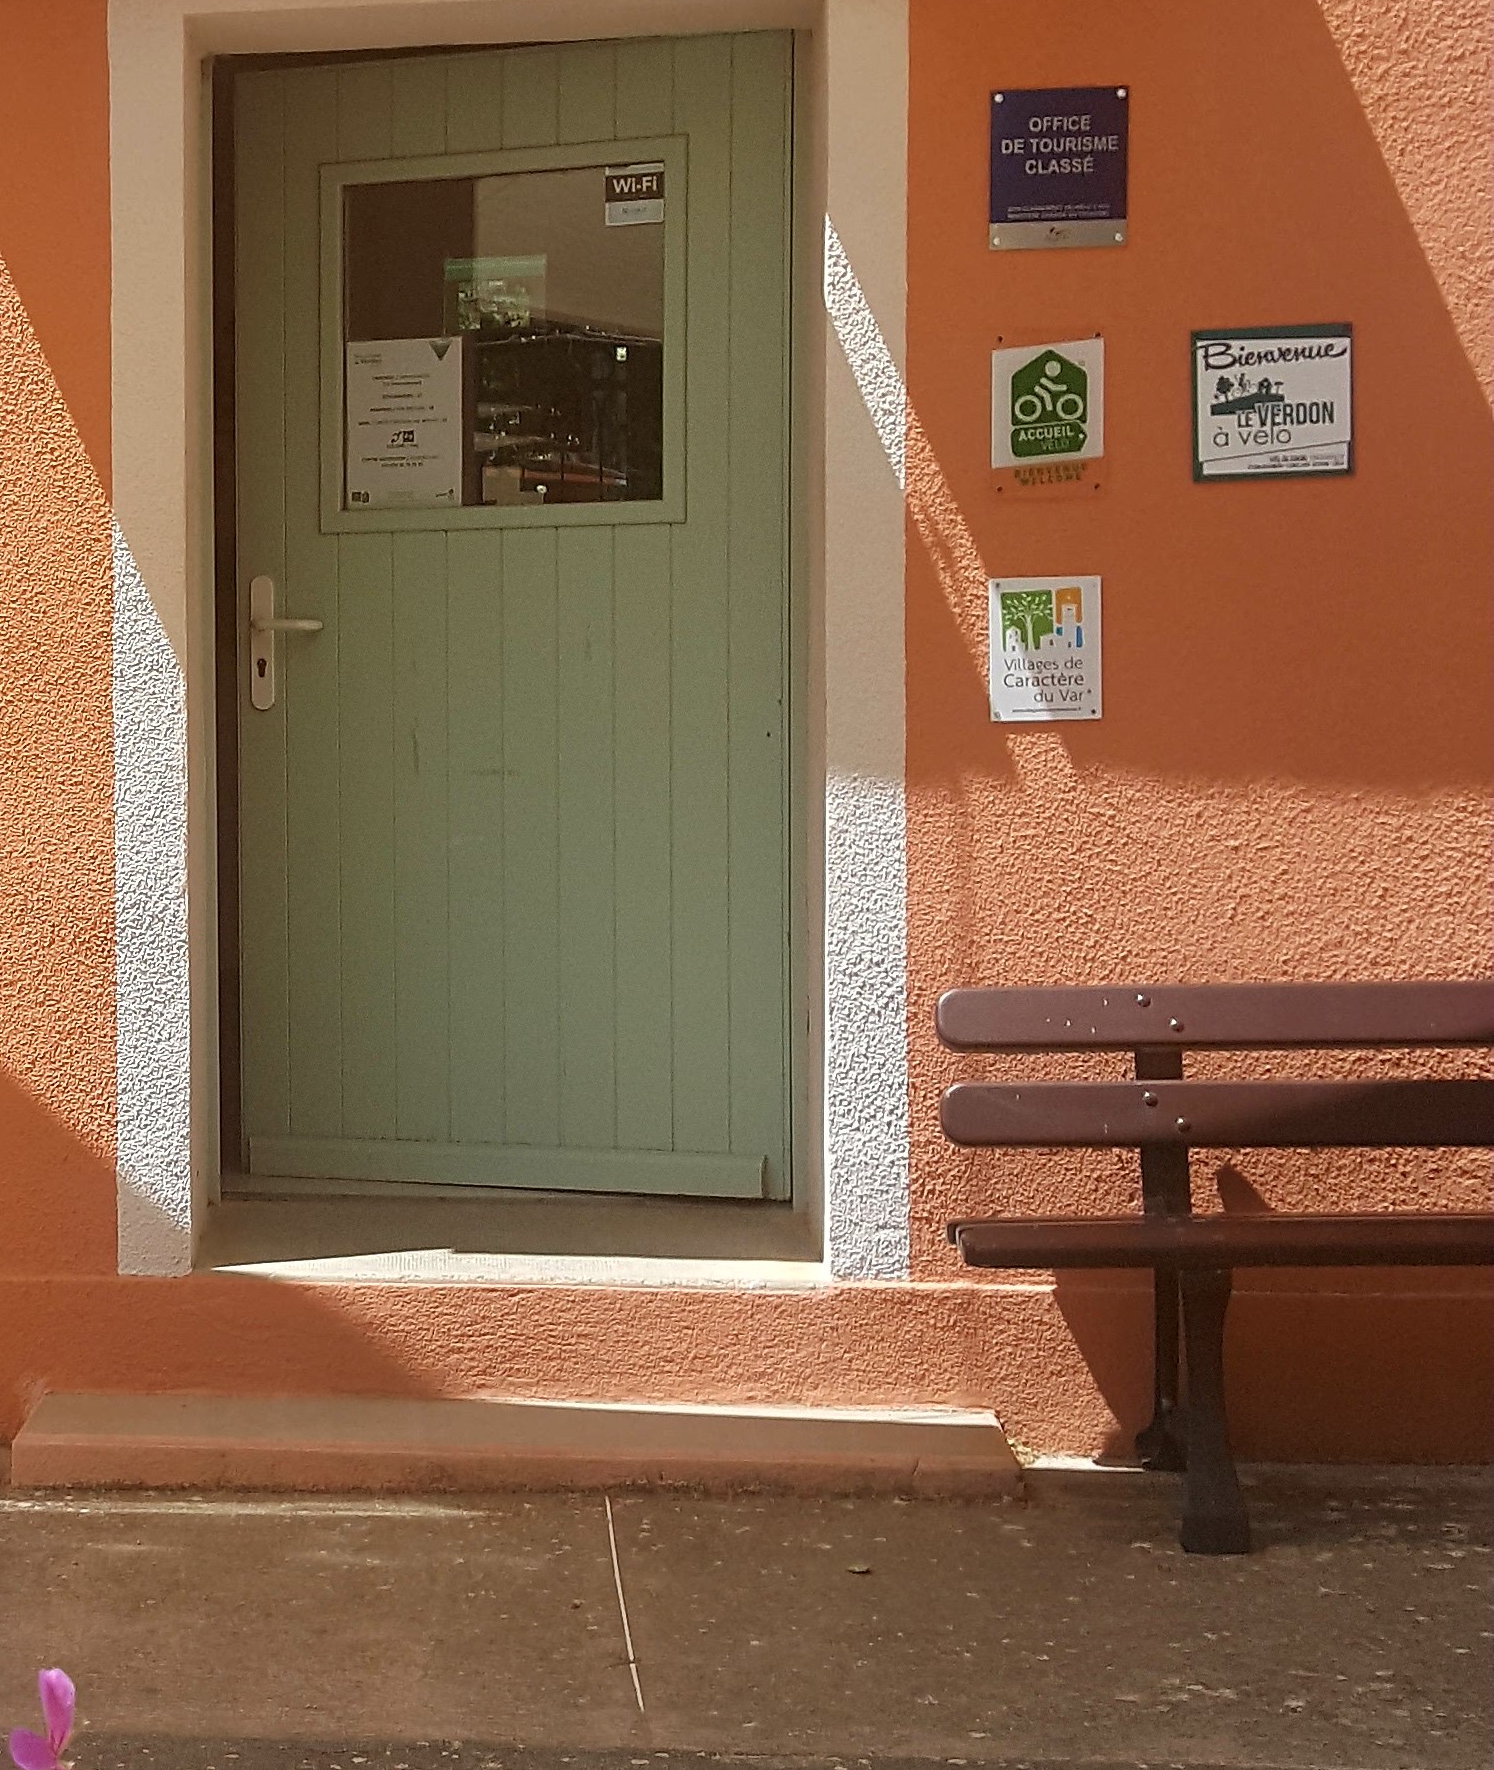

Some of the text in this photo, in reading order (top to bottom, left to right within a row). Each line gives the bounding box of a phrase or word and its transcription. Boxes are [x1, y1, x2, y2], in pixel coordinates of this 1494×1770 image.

[1028, 115, 1092, 132] OFFICE
[1001, 135, 1119, 154] DE TOURISME
[1025, 155, 1095, 175] CLASSÉ
[1196, 341, 1348, 371] Bienvenue
[1237, 401, 1335, 428] LE VERDON
[1019, 425, 1075, 441] ACCUEIL
[1213, 427, 1230, 447] à
[1004, 656, 1083, 673] Villages de
[1003, 672, 1084, 688] Caractère
[1034, 688, 1084, 703] du Var
